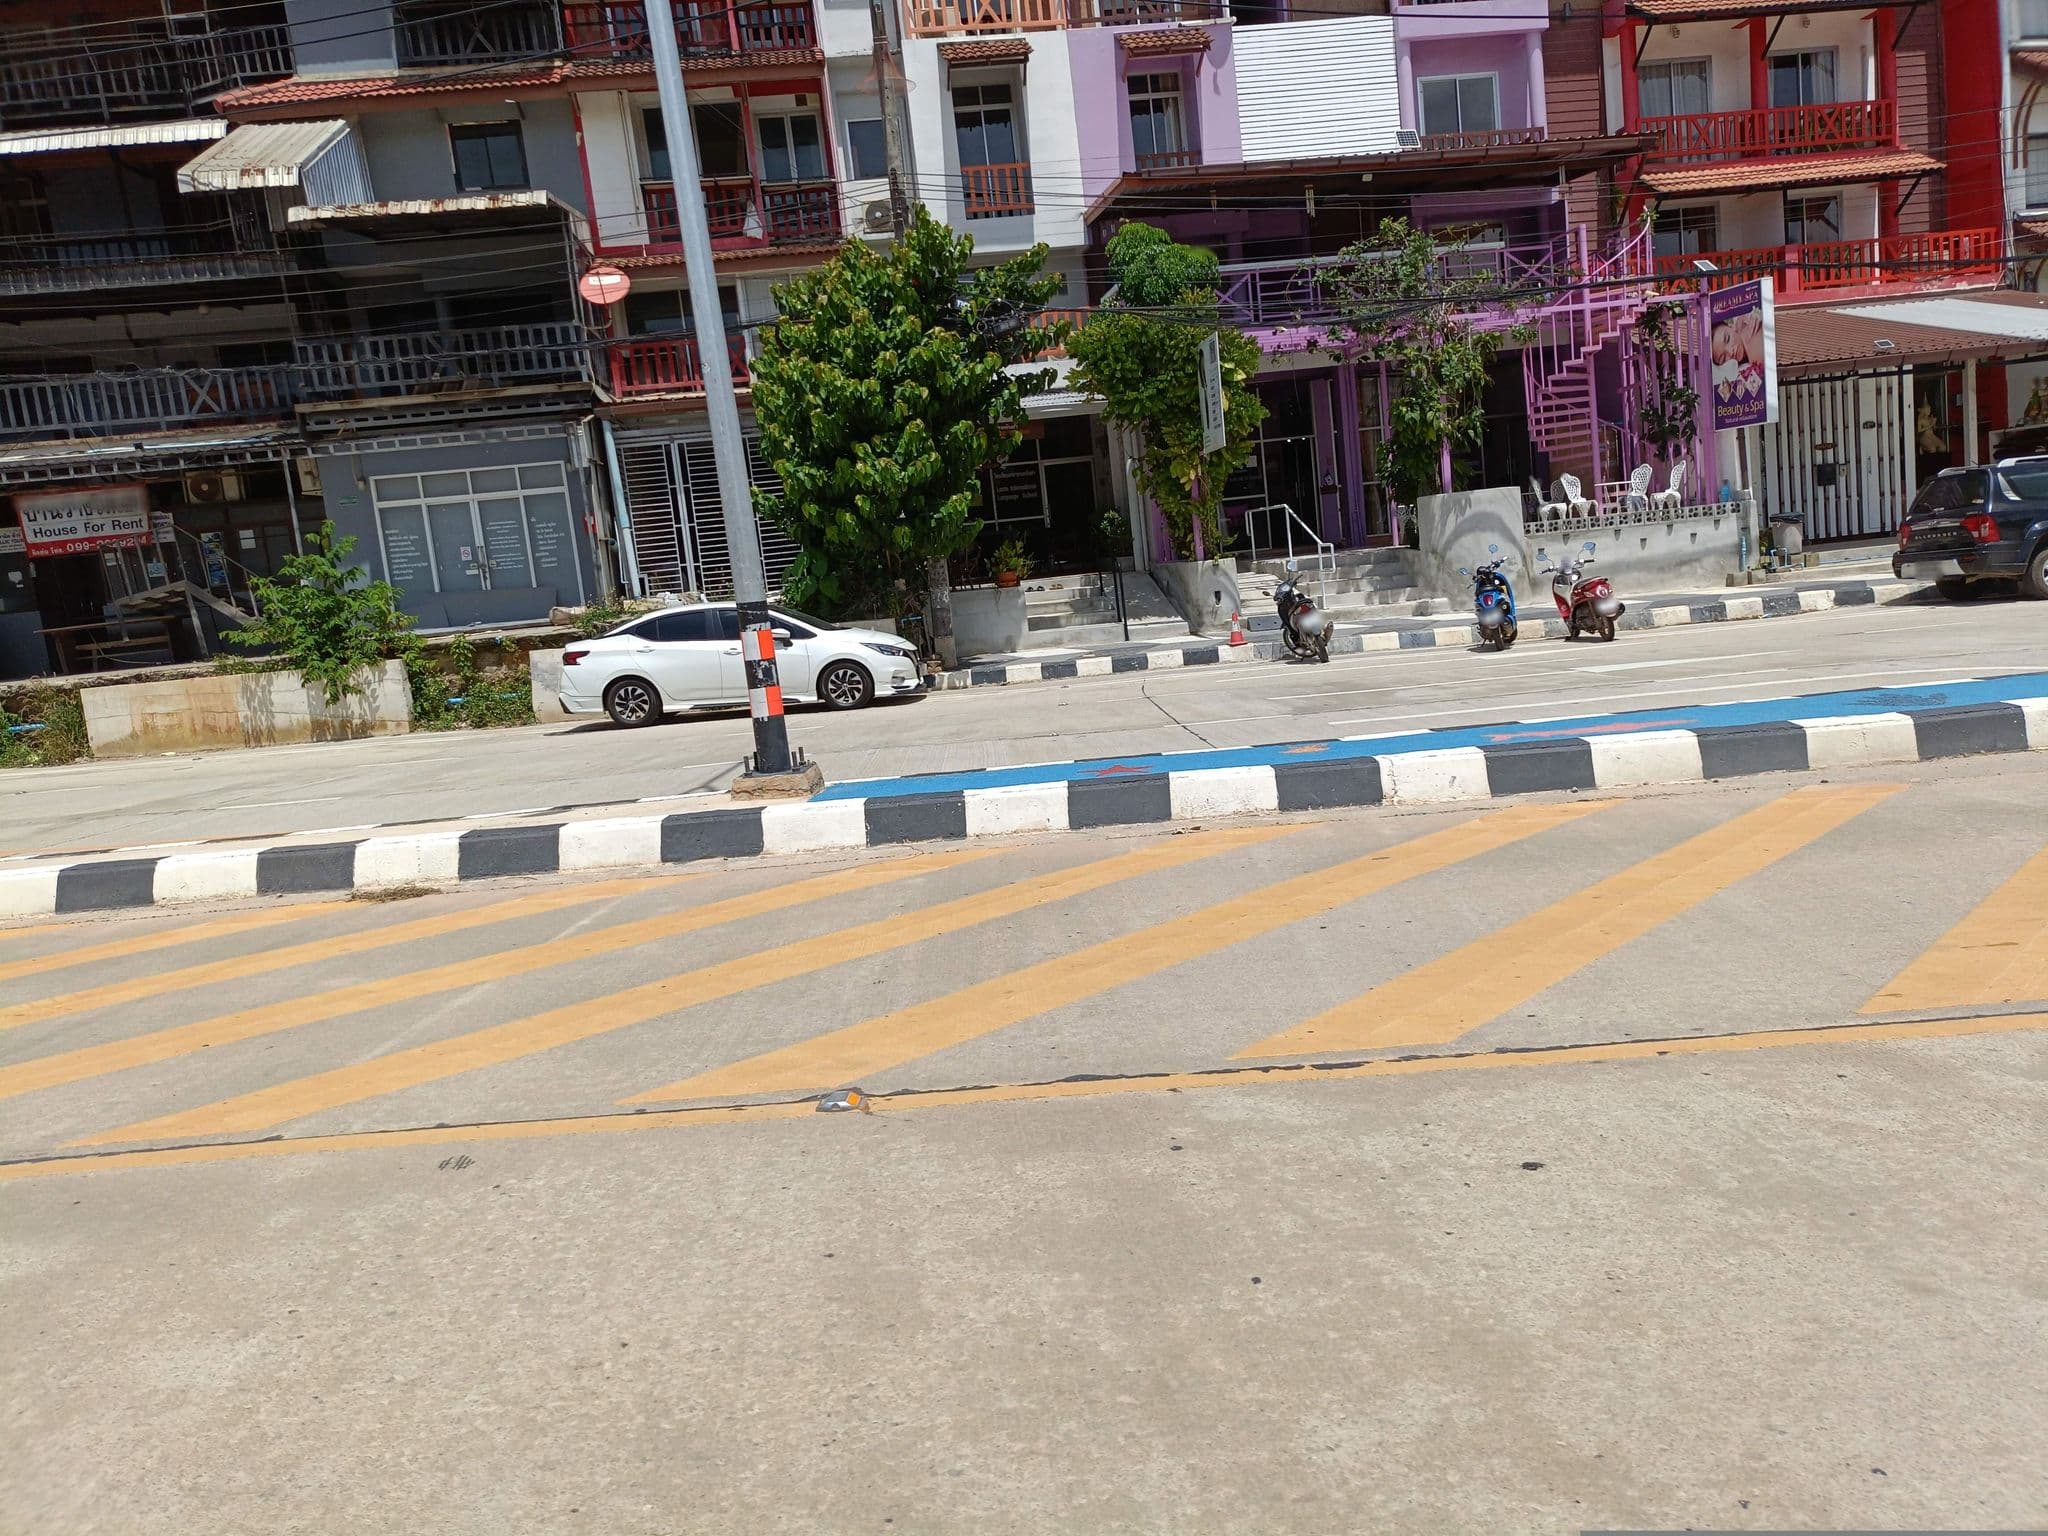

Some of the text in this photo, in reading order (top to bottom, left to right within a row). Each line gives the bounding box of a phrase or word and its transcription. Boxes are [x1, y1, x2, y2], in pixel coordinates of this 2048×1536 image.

[1745, 290, 1759, 302] SPA
[1718, 403, 1744, 417] Beauty
[1750, 400, 1764, 413] Spa
[33, 526, 78, 538] House
[84, 522, 106, 534] For
[112, 518, 144, 531] Rent
